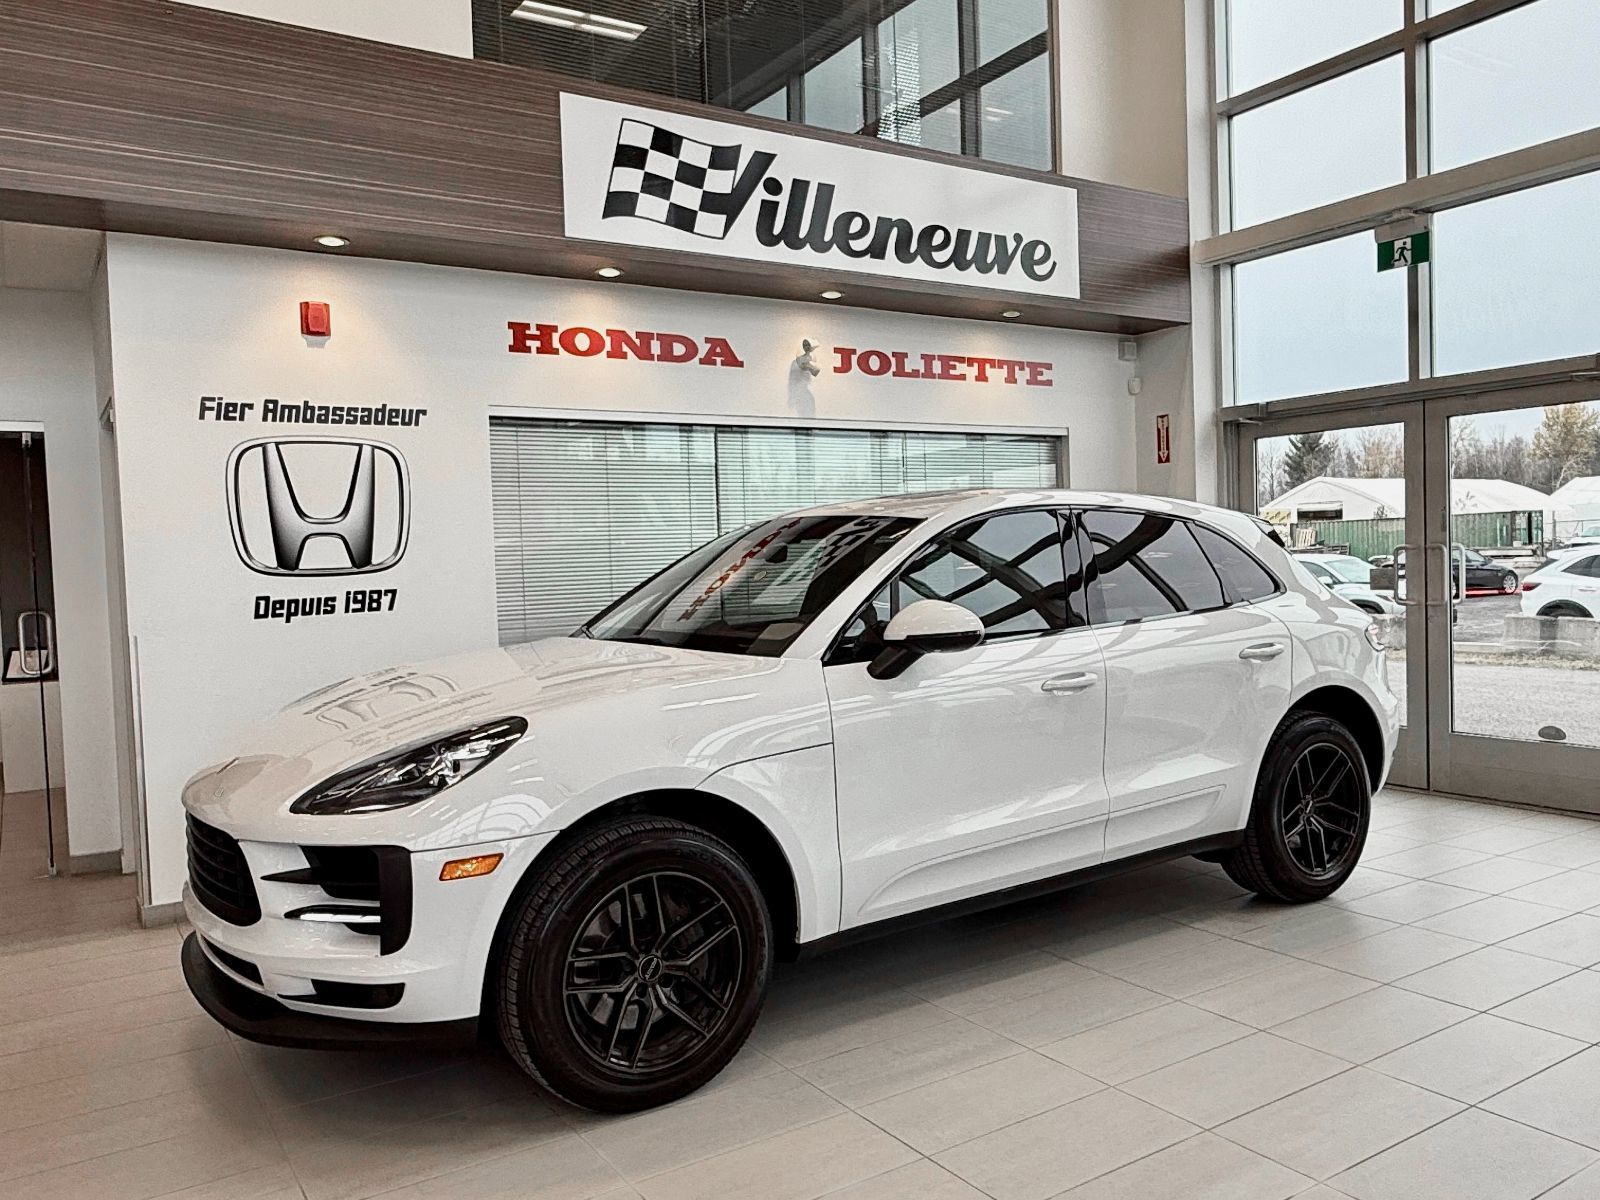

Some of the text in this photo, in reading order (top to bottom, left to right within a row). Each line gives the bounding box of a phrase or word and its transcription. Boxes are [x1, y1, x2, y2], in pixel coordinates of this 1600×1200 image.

[700, 144, 1057, 282] Villeneuve
[507, 320, 1053, 387] HONDA JOLIETTE
[198, 396, 427, 426] Fier Ambassadeur
[254, 589, 398, 623] Depuis 1987
